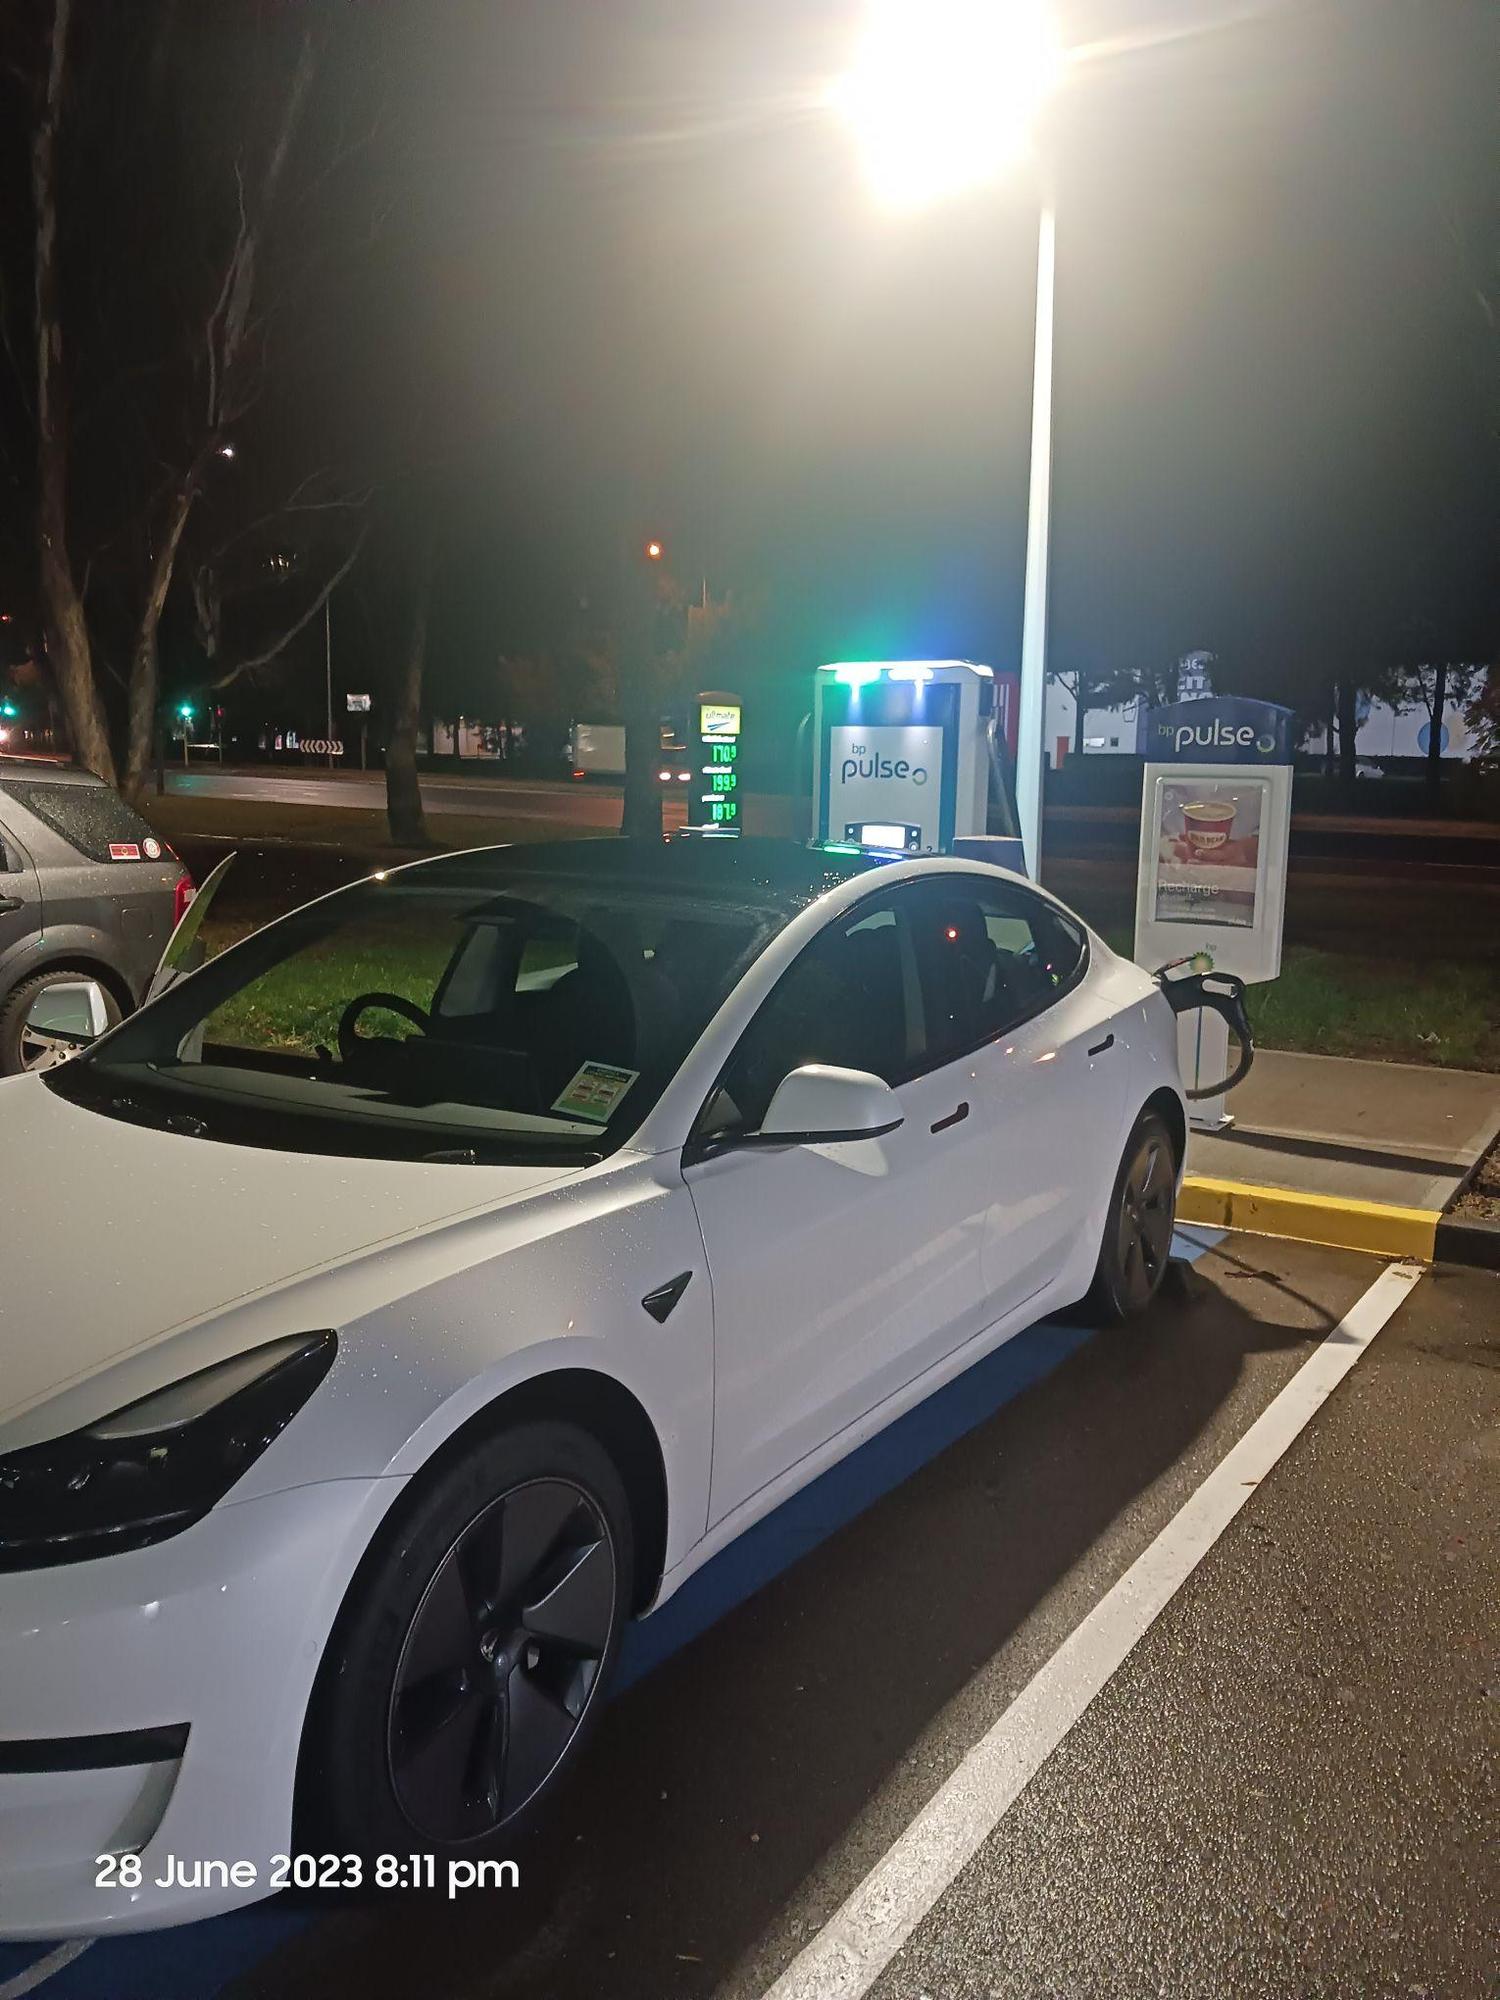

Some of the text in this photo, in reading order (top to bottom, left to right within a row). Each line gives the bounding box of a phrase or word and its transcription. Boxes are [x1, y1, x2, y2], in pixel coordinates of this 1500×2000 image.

[852, 743, 866, 756] bp
[1158, 718, 1255, 752] bp pulse
[842, 752, 910, 784] pulse
